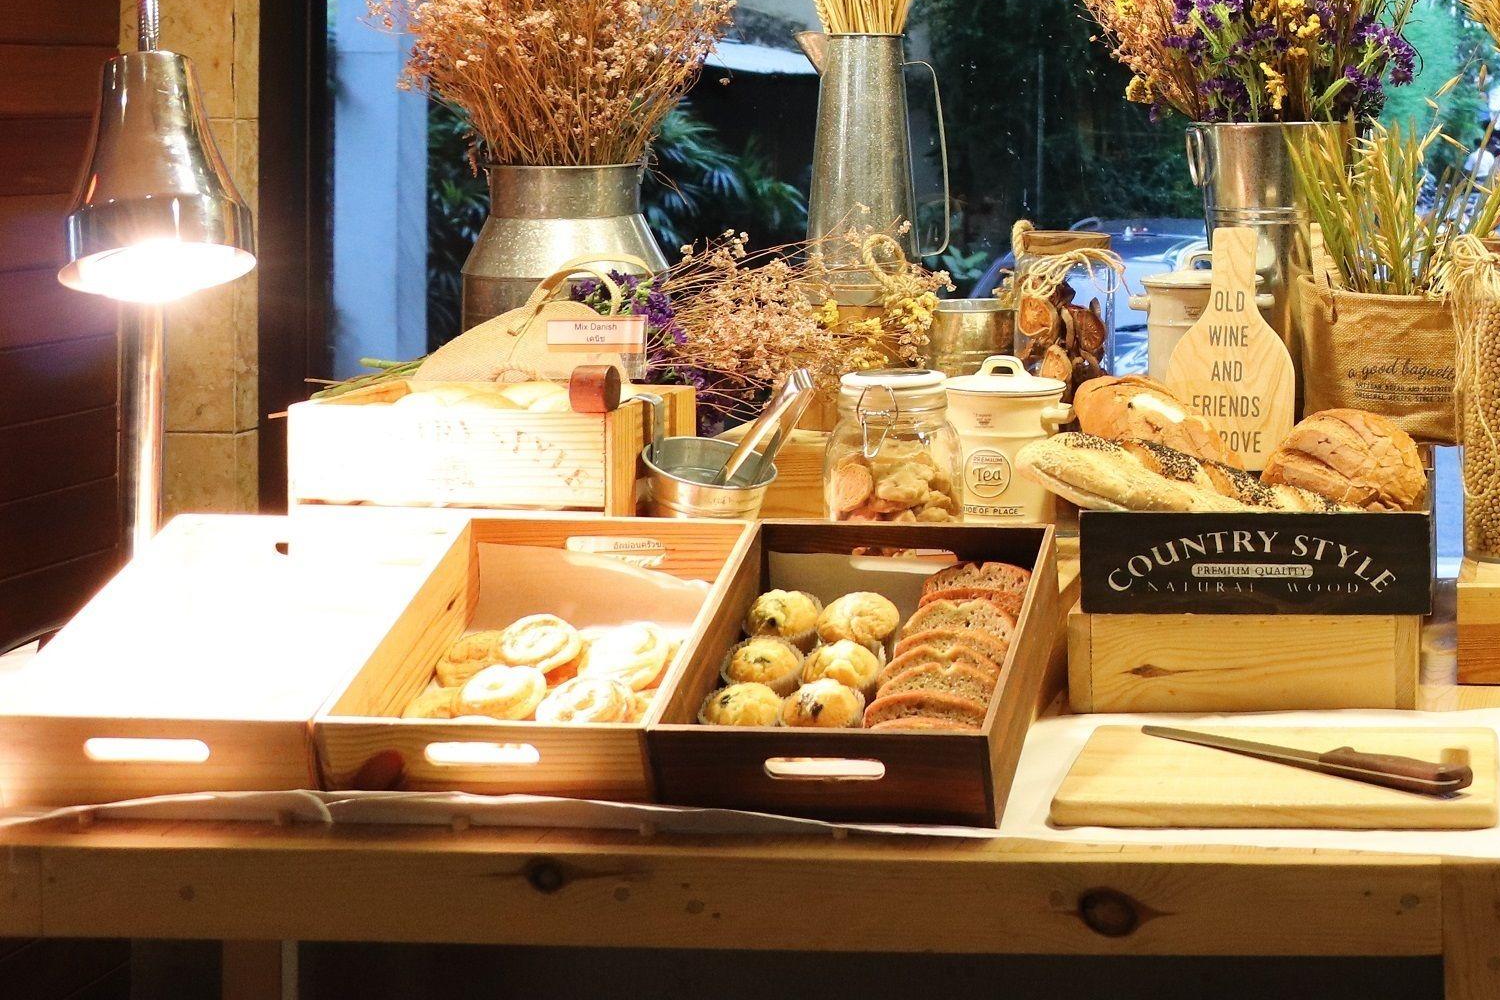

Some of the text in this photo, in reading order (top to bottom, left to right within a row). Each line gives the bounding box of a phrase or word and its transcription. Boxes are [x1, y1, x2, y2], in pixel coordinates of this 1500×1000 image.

[1215, 291, 1245, 313] OLD
[574, 323, 618, 331] Mix Danish
[1208, 325, 1249, 348] WINE
[1211, 361, 1243, 382] AND
[1348, 368, 1356, 378] a
[1361, 358, 1399, 380] good
[1192, 395, 1261, 418] FRIENDS
[1219, 431, 1262, 453] ROVE
[972, 467, 1002, 481] Tea
[1107, 530, 1397, 593] COUNTRY STYLE
[1196, 566, 1310, 576] PREMIUM QUALITY
